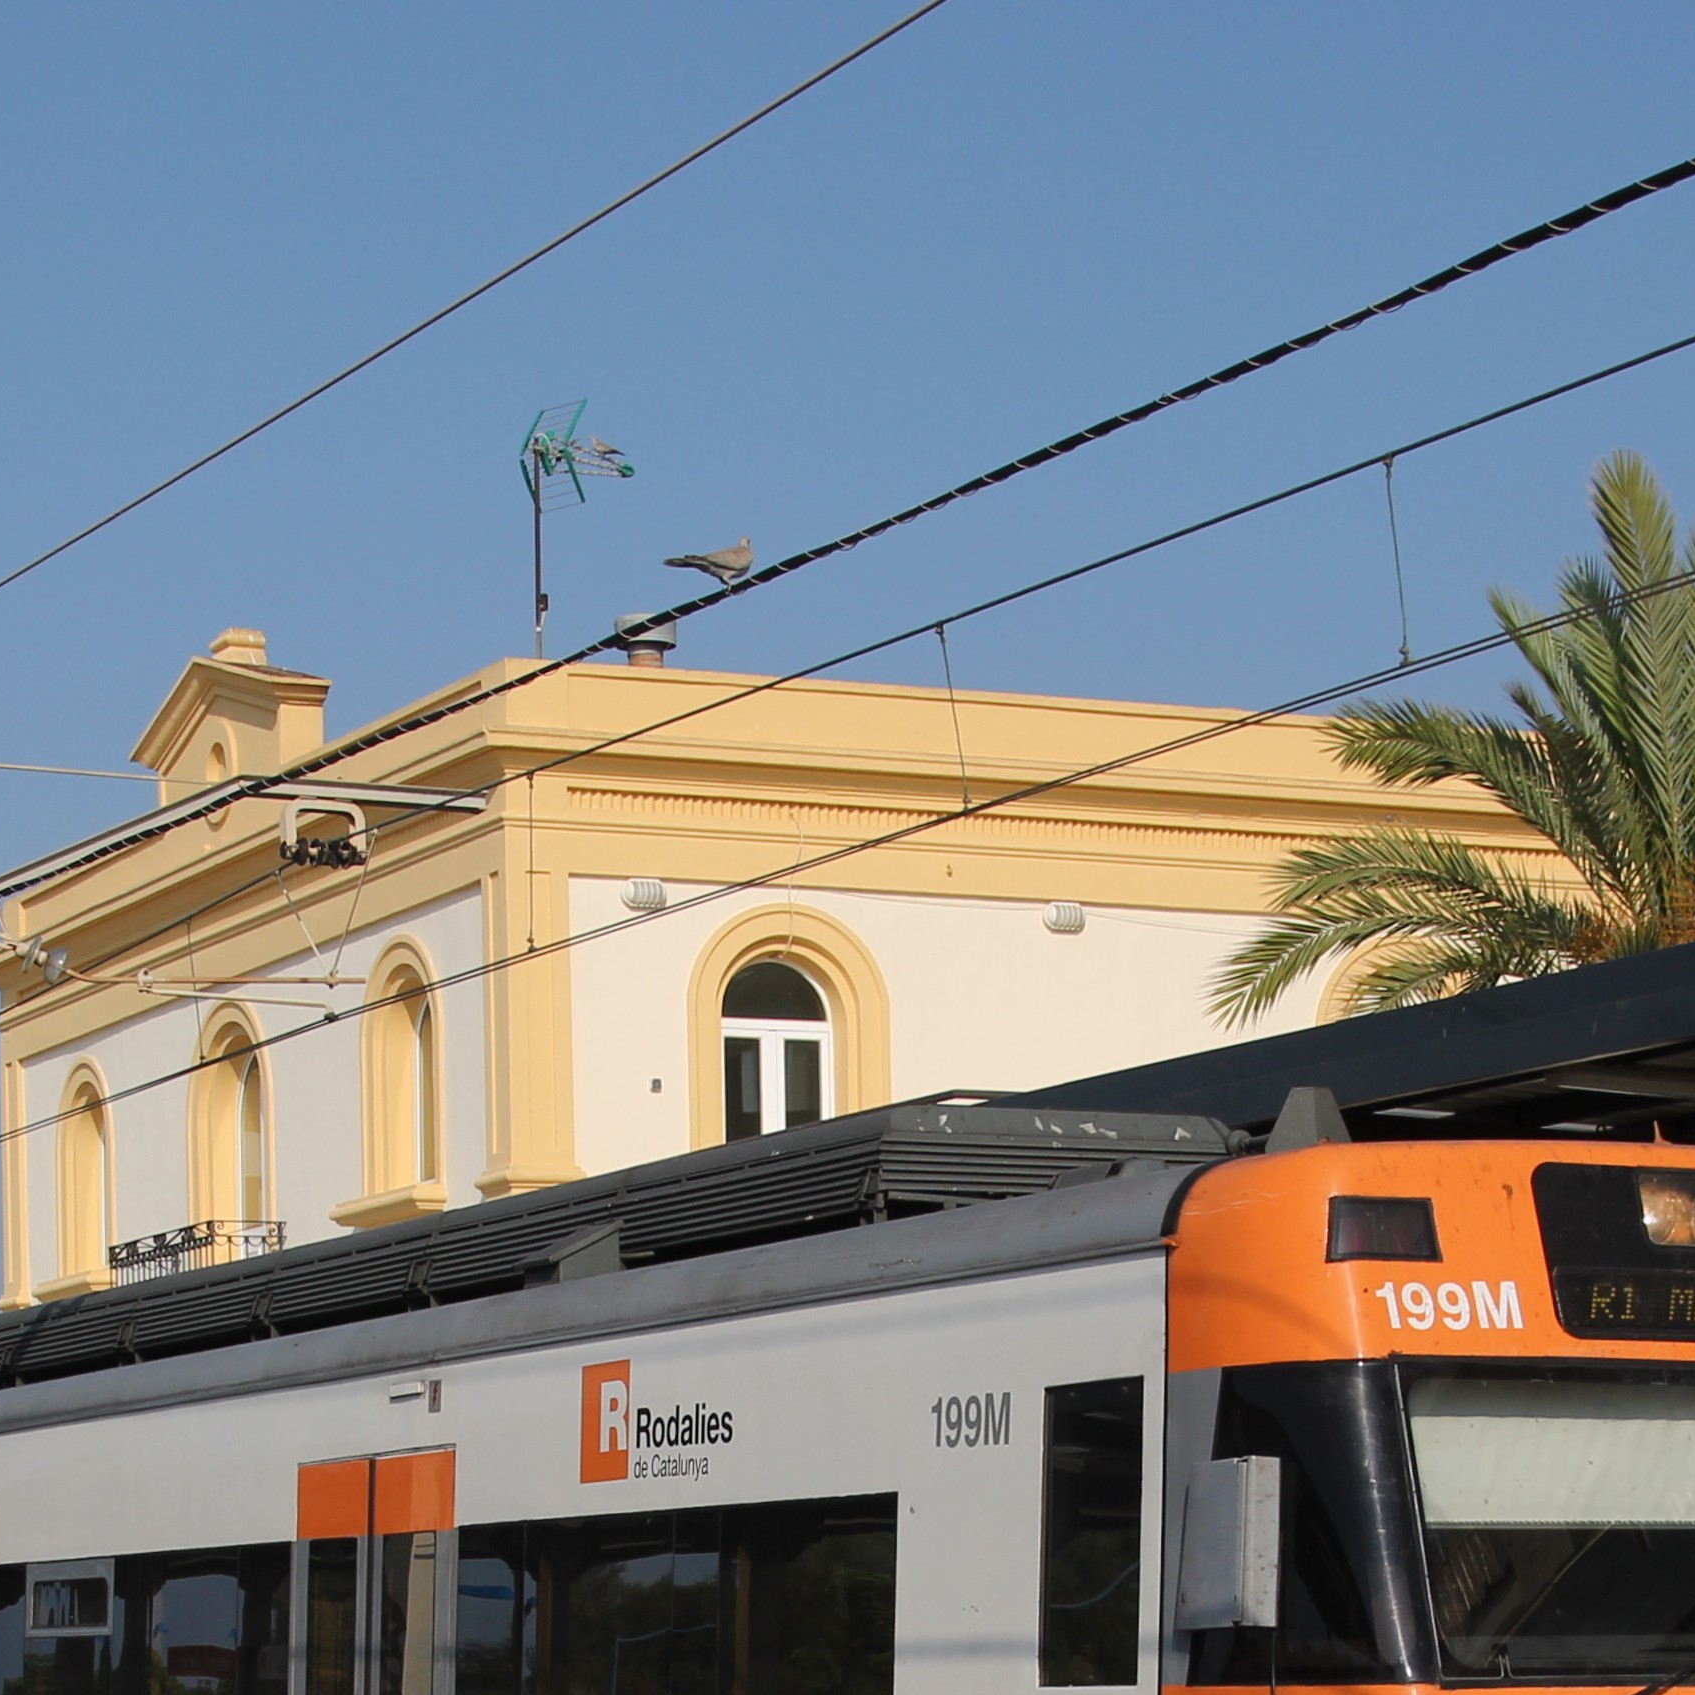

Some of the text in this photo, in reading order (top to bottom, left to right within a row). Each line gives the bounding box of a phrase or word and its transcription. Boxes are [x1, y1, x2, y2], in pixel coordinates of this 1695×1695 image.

[1374, 1280, 1524, 1331] 199M
[1590, 1284, 1635, 1319] R1
[599, 1379, 628, 1454] R
[635, 1402, 733, 1449] Rodalies
[931, 1391, 1011, 1448] 199M
[633, 1453, 709, 1482] de Catalunya
